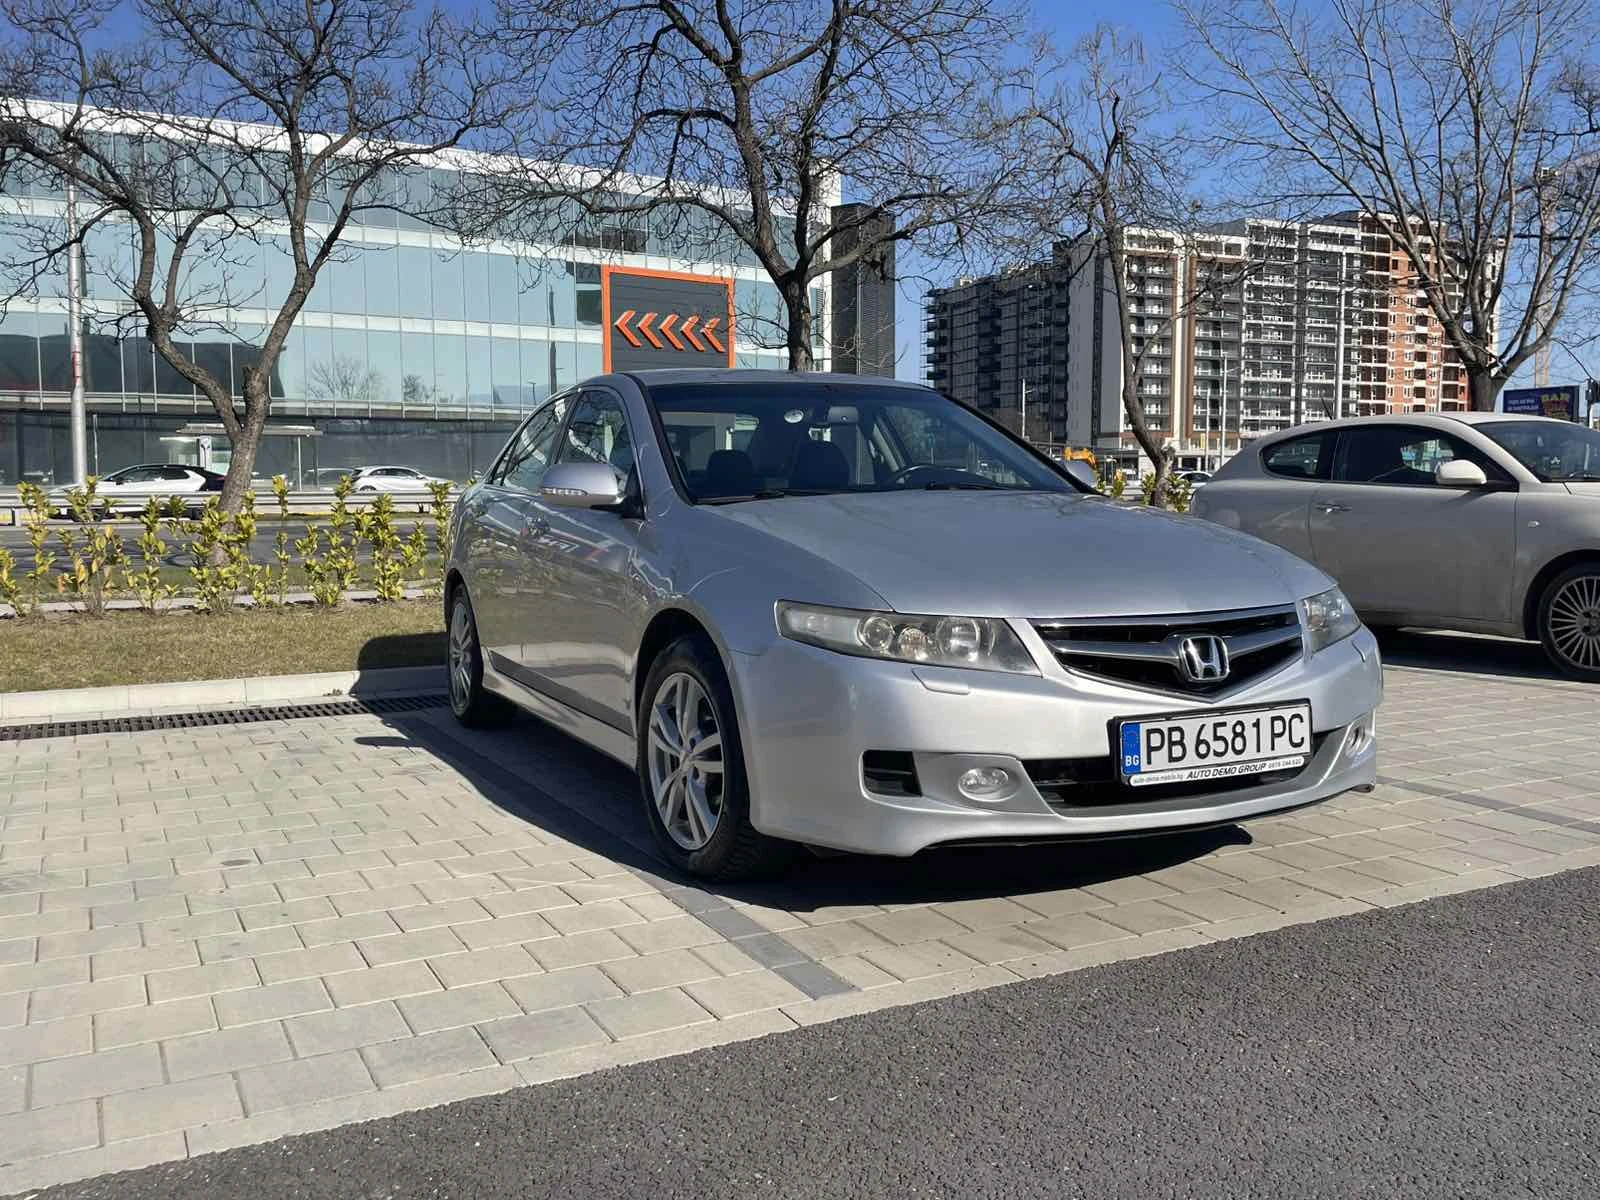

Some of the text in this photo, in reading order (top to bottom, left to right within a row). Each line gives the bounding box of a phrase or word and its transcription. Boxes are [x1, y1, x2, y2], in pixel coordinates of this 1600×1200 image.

[1146, 713, 1305, 765] PB 6581 PC
[1125, 755, 1140, 766] BG
[1186, 762, 1267, 780] AUTO DEMO GROUP
